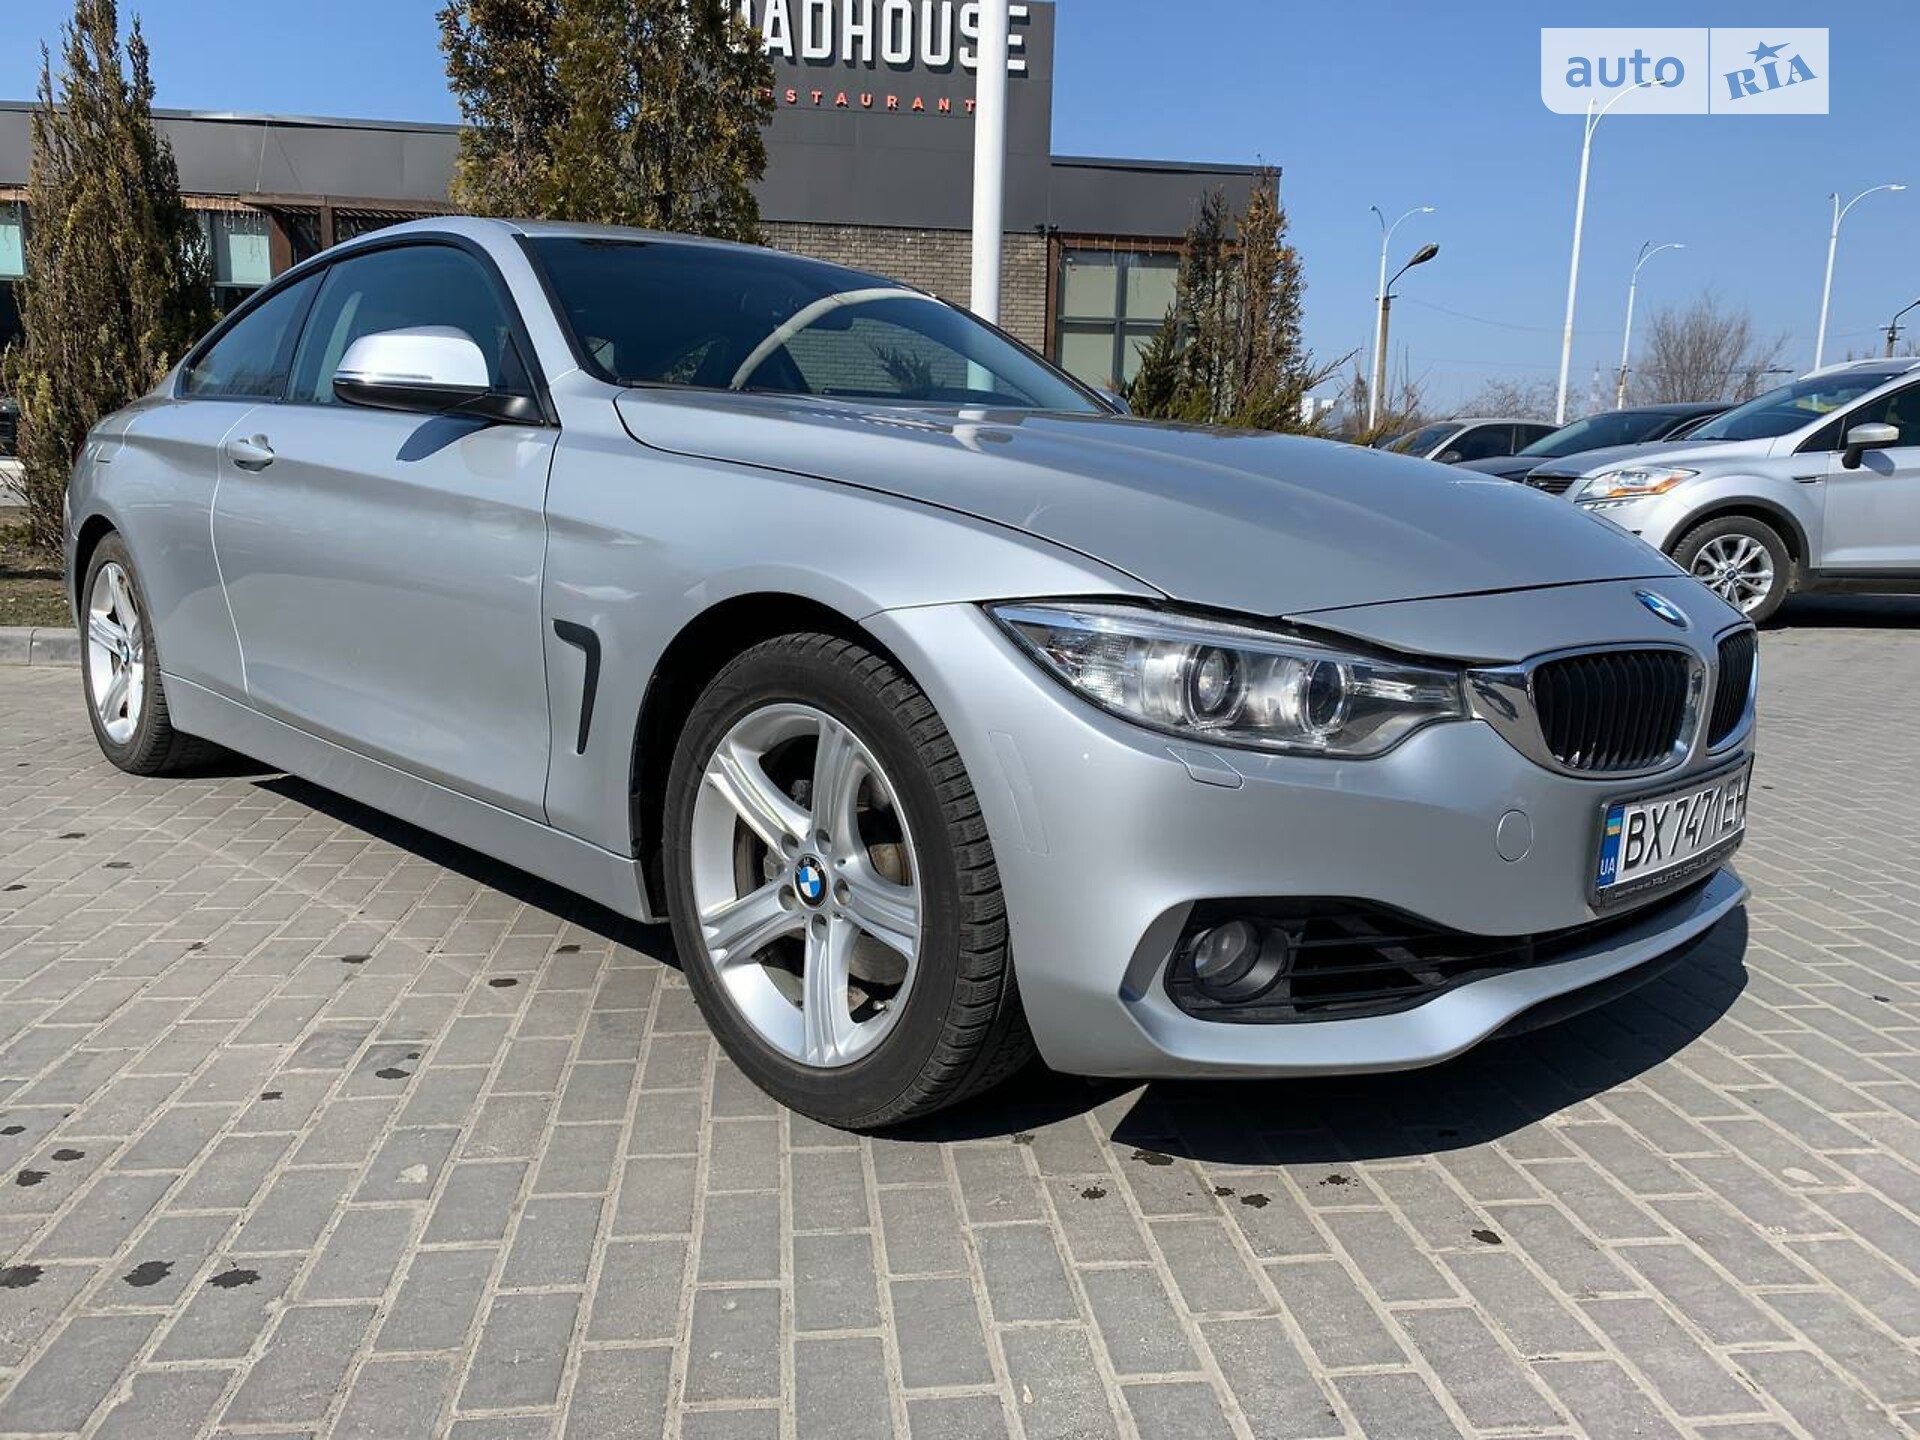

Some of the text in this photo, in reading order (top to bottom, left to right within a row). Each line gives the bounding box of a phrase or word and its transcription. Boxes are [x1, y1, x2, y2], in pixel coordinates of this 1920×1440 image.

[680, 0, 1028, 70] OADHOUSE
[1621, 803, 1670, 871] BX
[1668, 786, 1723, 857] 7471
[1600, 857, 1617, 876] UA
